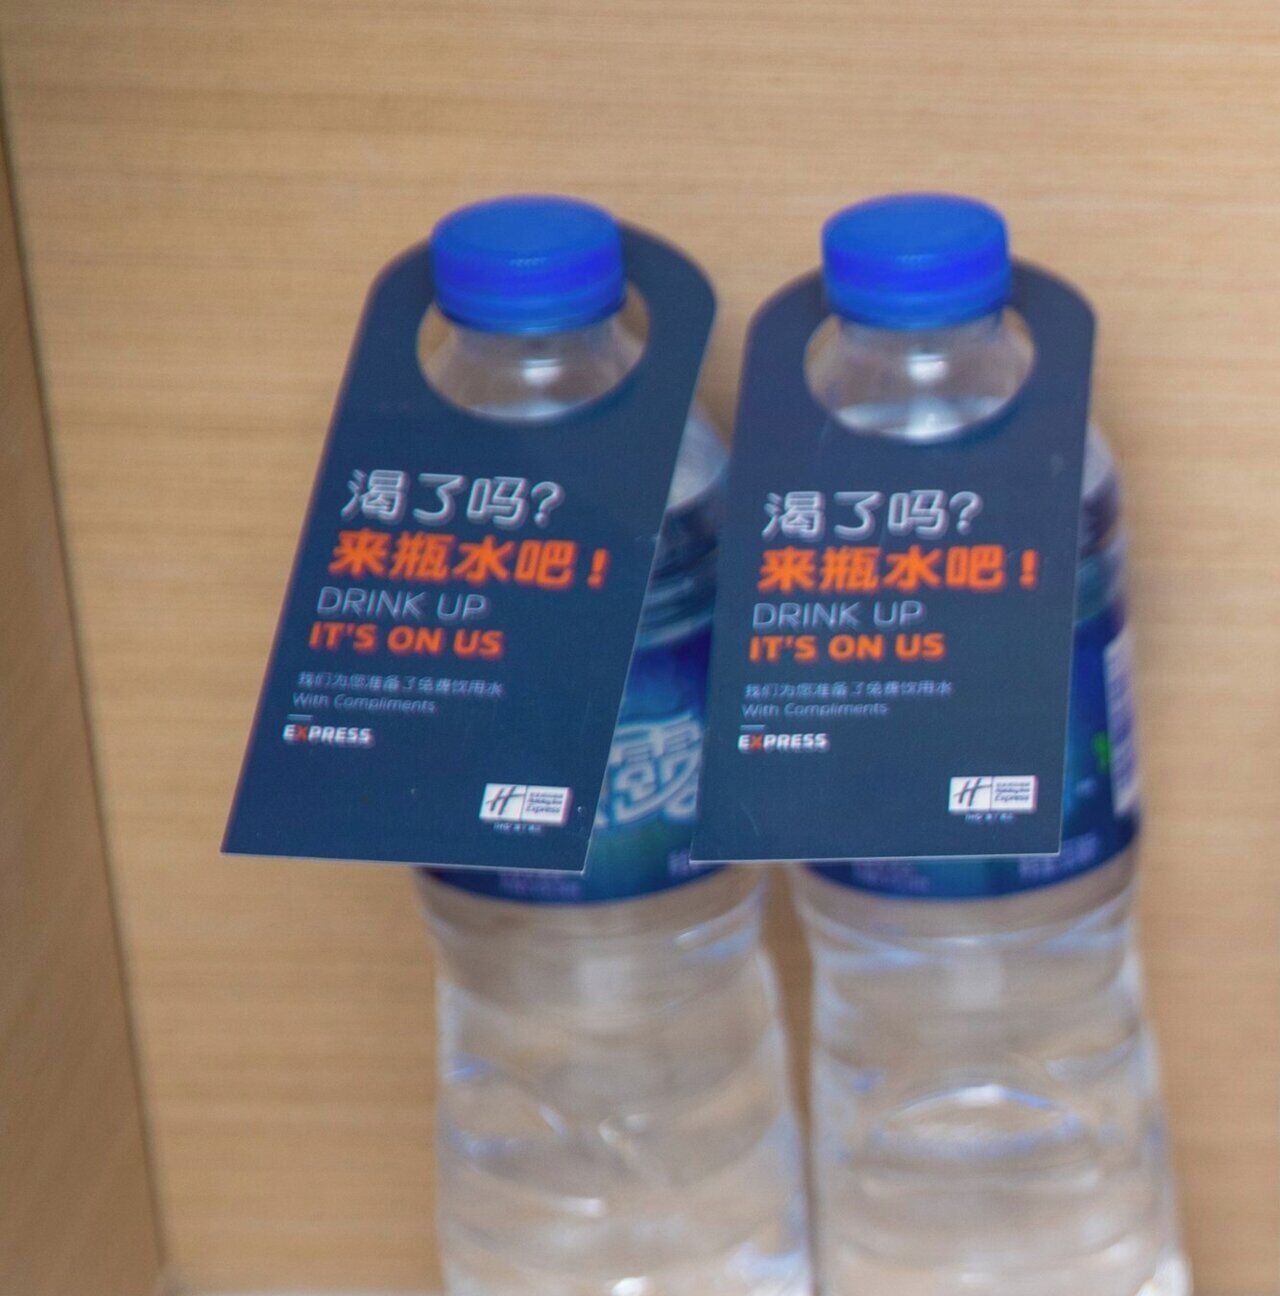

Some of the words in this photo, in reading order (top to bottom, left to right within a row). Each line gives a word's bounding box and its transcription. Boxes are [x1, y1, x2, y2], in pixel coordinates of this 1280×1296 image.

[316, 586, 426, 621] DRINK
[437, 593, 487, 622] UP
[752, 602, 859, 631] DRINK
[873, 600, 926, 627] UP
[309, 622, 377, 650] IT'S
[387, 625, 443, 655] ON
[453, 628, 504, 658] US
[748, 635, 818, 662] IT'S
[827, 634, 884, 660] ON
[894, 633, 946, 658] US
[293, 692, 330, 706] With
[333, 694, 437, 713] Compliments
[741, 703, 780, 718] With
[783, 701, 889, 719] Compliments
[282, 724, 374, 745] EXPRESS
[738, 733, 829, 752] EXPRESS
